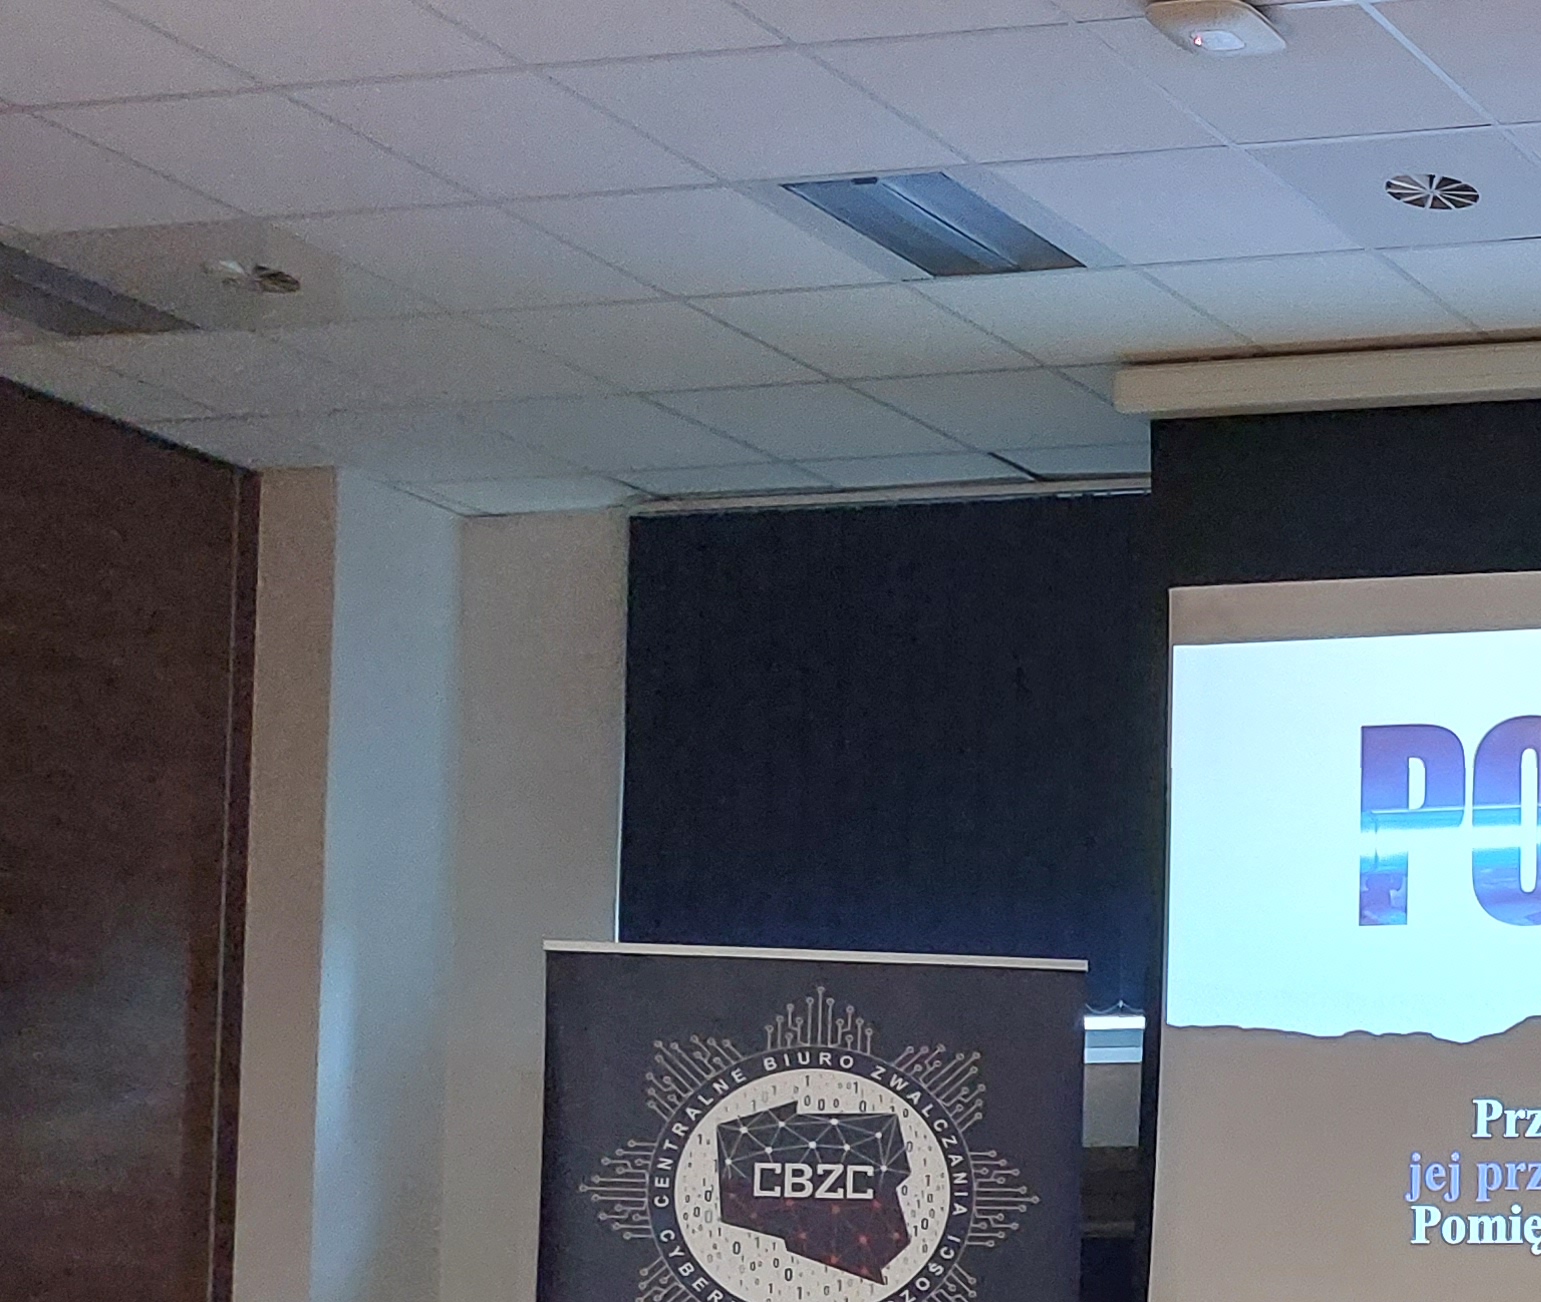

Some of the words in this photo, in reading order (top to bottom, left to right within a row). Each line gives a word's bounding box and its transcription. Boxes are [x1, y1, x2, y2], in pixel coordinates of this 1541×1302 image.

[655, 1068, 747, 1208] CENTRALNE
[763, 1050, 855, 1073] BIURO
[870, 1065, 969, 1217] ZWALCZANIA
[753, 1162, 875, 1200] CBZC
[1405, 1151, 1460, 1202] jej
